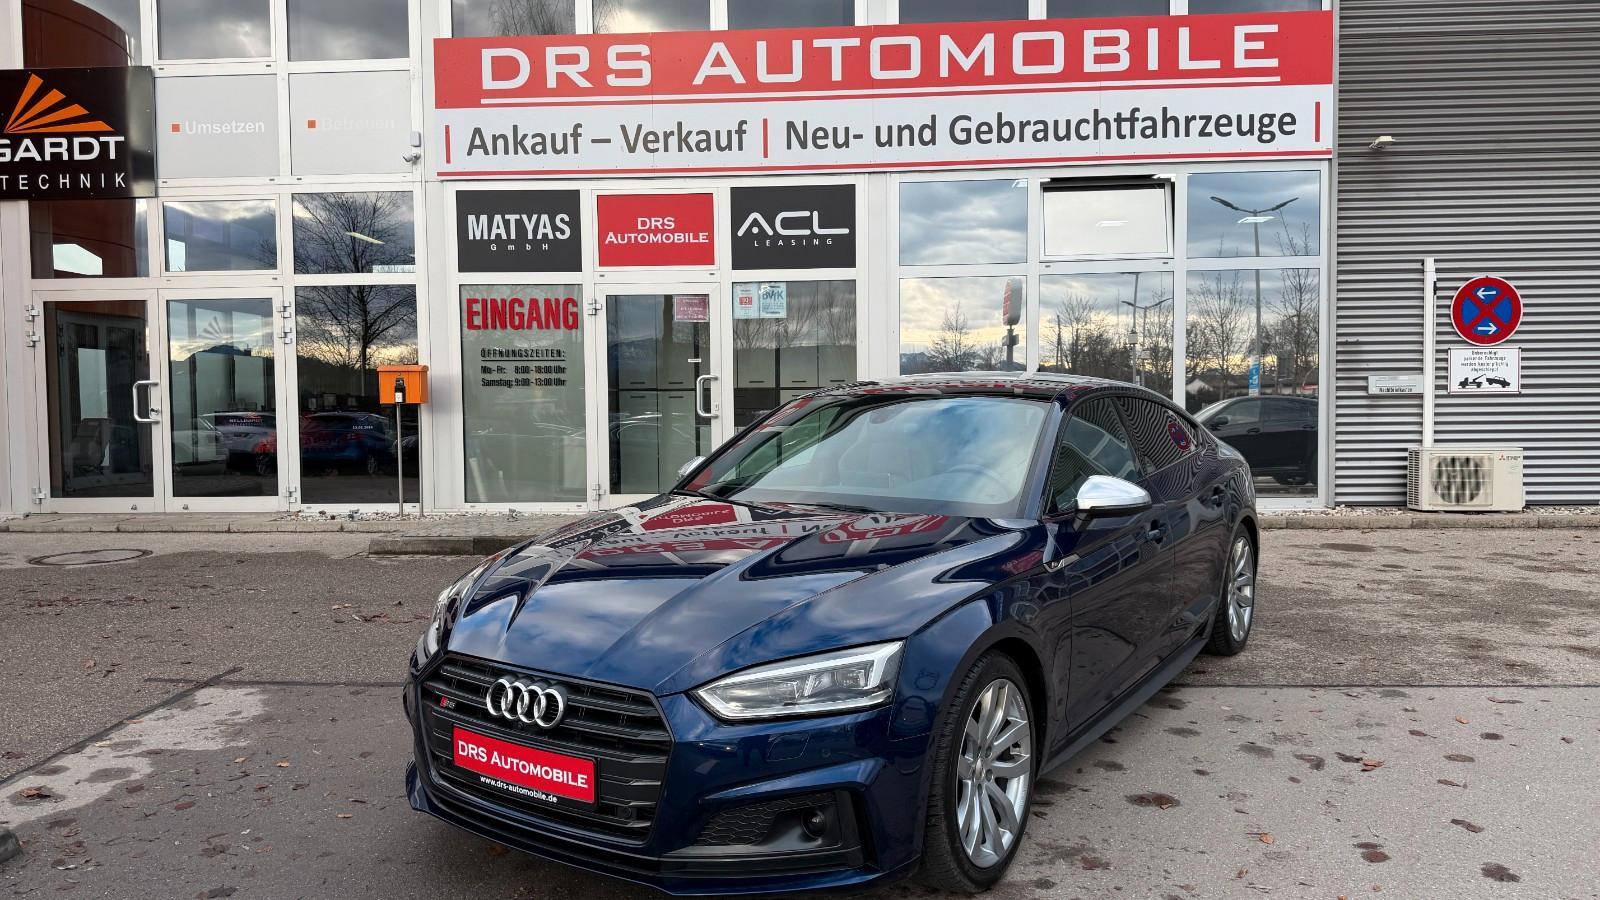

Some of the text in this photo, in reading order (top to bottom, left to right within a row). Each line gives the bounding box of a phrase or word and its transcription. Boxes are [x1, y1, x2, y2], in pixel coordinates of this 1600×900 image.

[481, 24, 1280, 90] DRS AUTOMOBILE
[185, 120, 265, 135] Umsetzen
[466, 123, 583, 156] Ankauf
[620, 119, 748, 154] Verkauf
[785, 120, 864, 151] Neu-
[874, 114, 938, 148] und
[948, 106, 1297, 146] Gebrauchtfahrzeuge
[467, 213, 571, 241] MATYAS
[637, 217, 675, 230] DRS
[737, 210, 850, 237] ACL
[605, 231, 708, 244] AUTOMOBILE
[754, 238, 833, 247] LEASING
[466, 297, 579, 331] EINGANG
[480, 347, 566, 358] ÖFFNUNGSZEITEN:
[553, 365, 567, 374] Uhr
[481, 377, 513, 388] Samstag:
[553, 377, 567, 386] Uhr
[458, 740, 588, 789] DRS AUTOMOBILE
[479, 775, 558, 803] www.drs-automobile.de
